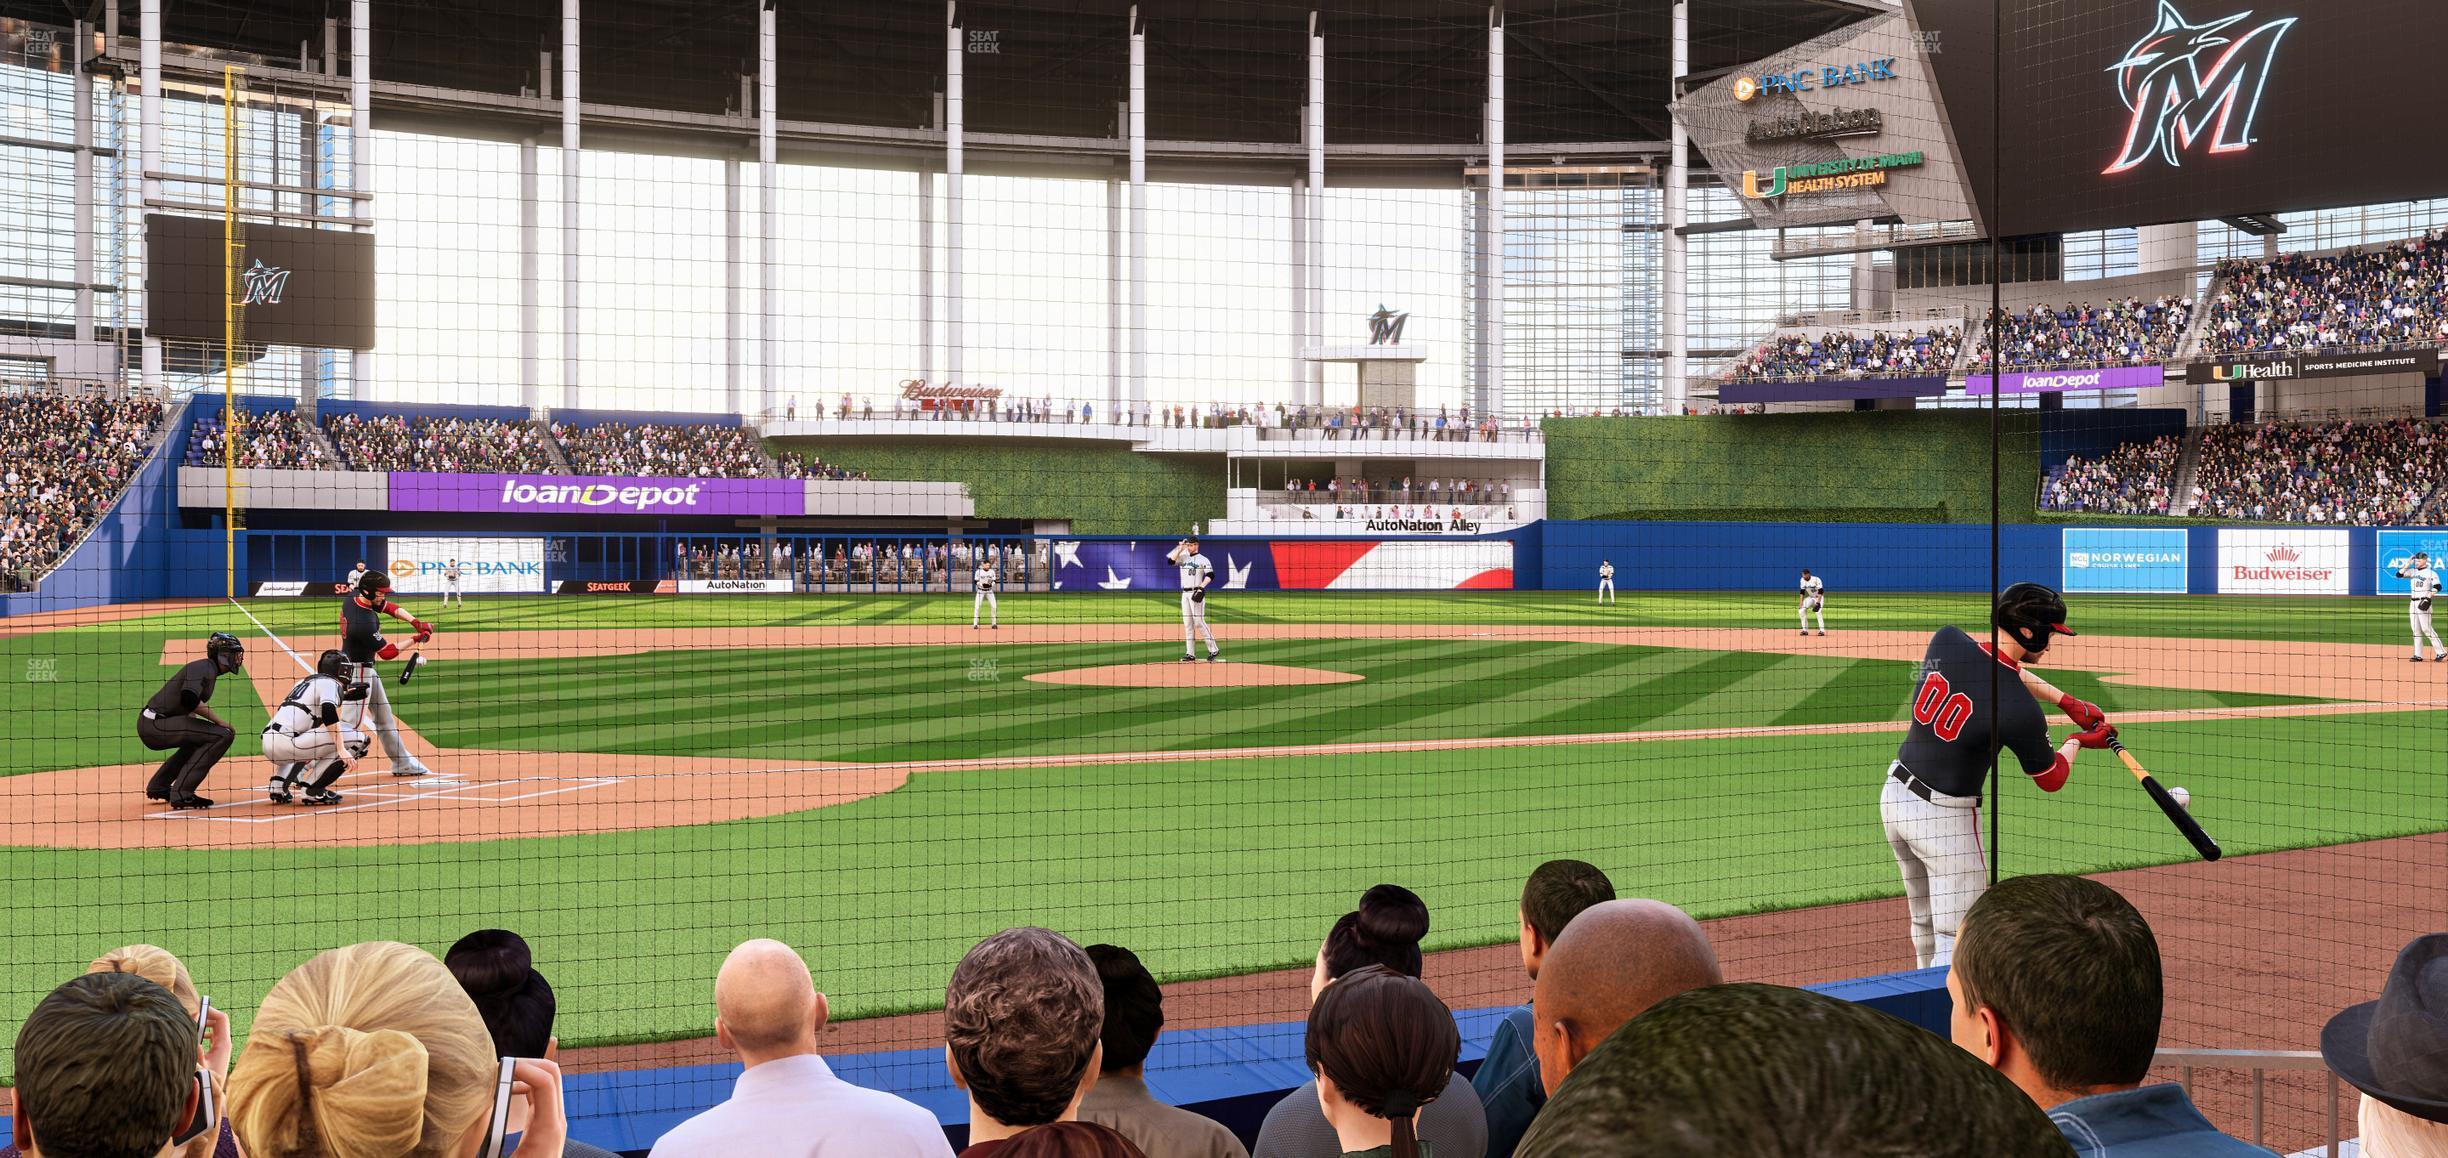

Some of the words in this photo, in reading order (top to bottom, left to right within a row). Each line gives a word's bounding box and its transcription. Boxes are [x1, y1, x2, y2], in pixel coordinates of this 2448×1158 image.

[1760, 69, 1814, 96] PNC
[1822, 56, 1897, 88] BANK
[1789, 158, 1858, 178] UNIVERSITY
[1859, 155, 1879, 169] OF
[1879, 151, 1923, 168] MIAMI
[1788, 177, 1835, 194] HEALTH
[1835, 171, 1886, 188] SYSTEM
[2304, 362, 2334, 371] SPORTS
[2335, 360, 2373, 370] MEDICINE
[2374, 357, 2416, 367] INSTITUTE
[2022, 372, 2101, 389] loanDepot
[899, 378, 1004, 400] Budweiser
[502, 479, 700, 511] loanDepot
[1365, 519, 1443, 532] AutoNation
[1449, 519, 1481, 535] Alley
[2091, 553, 2181, 563] NORWEGIAN
[477, 561, 541, 576] BANK
[2233, 565, 2333, 580] Budweiser
[586, 581, 631, 592] SEATGEEK
[706, 580, 766, 590] AutoNation
[1913, 671, 1974, 742] 00
